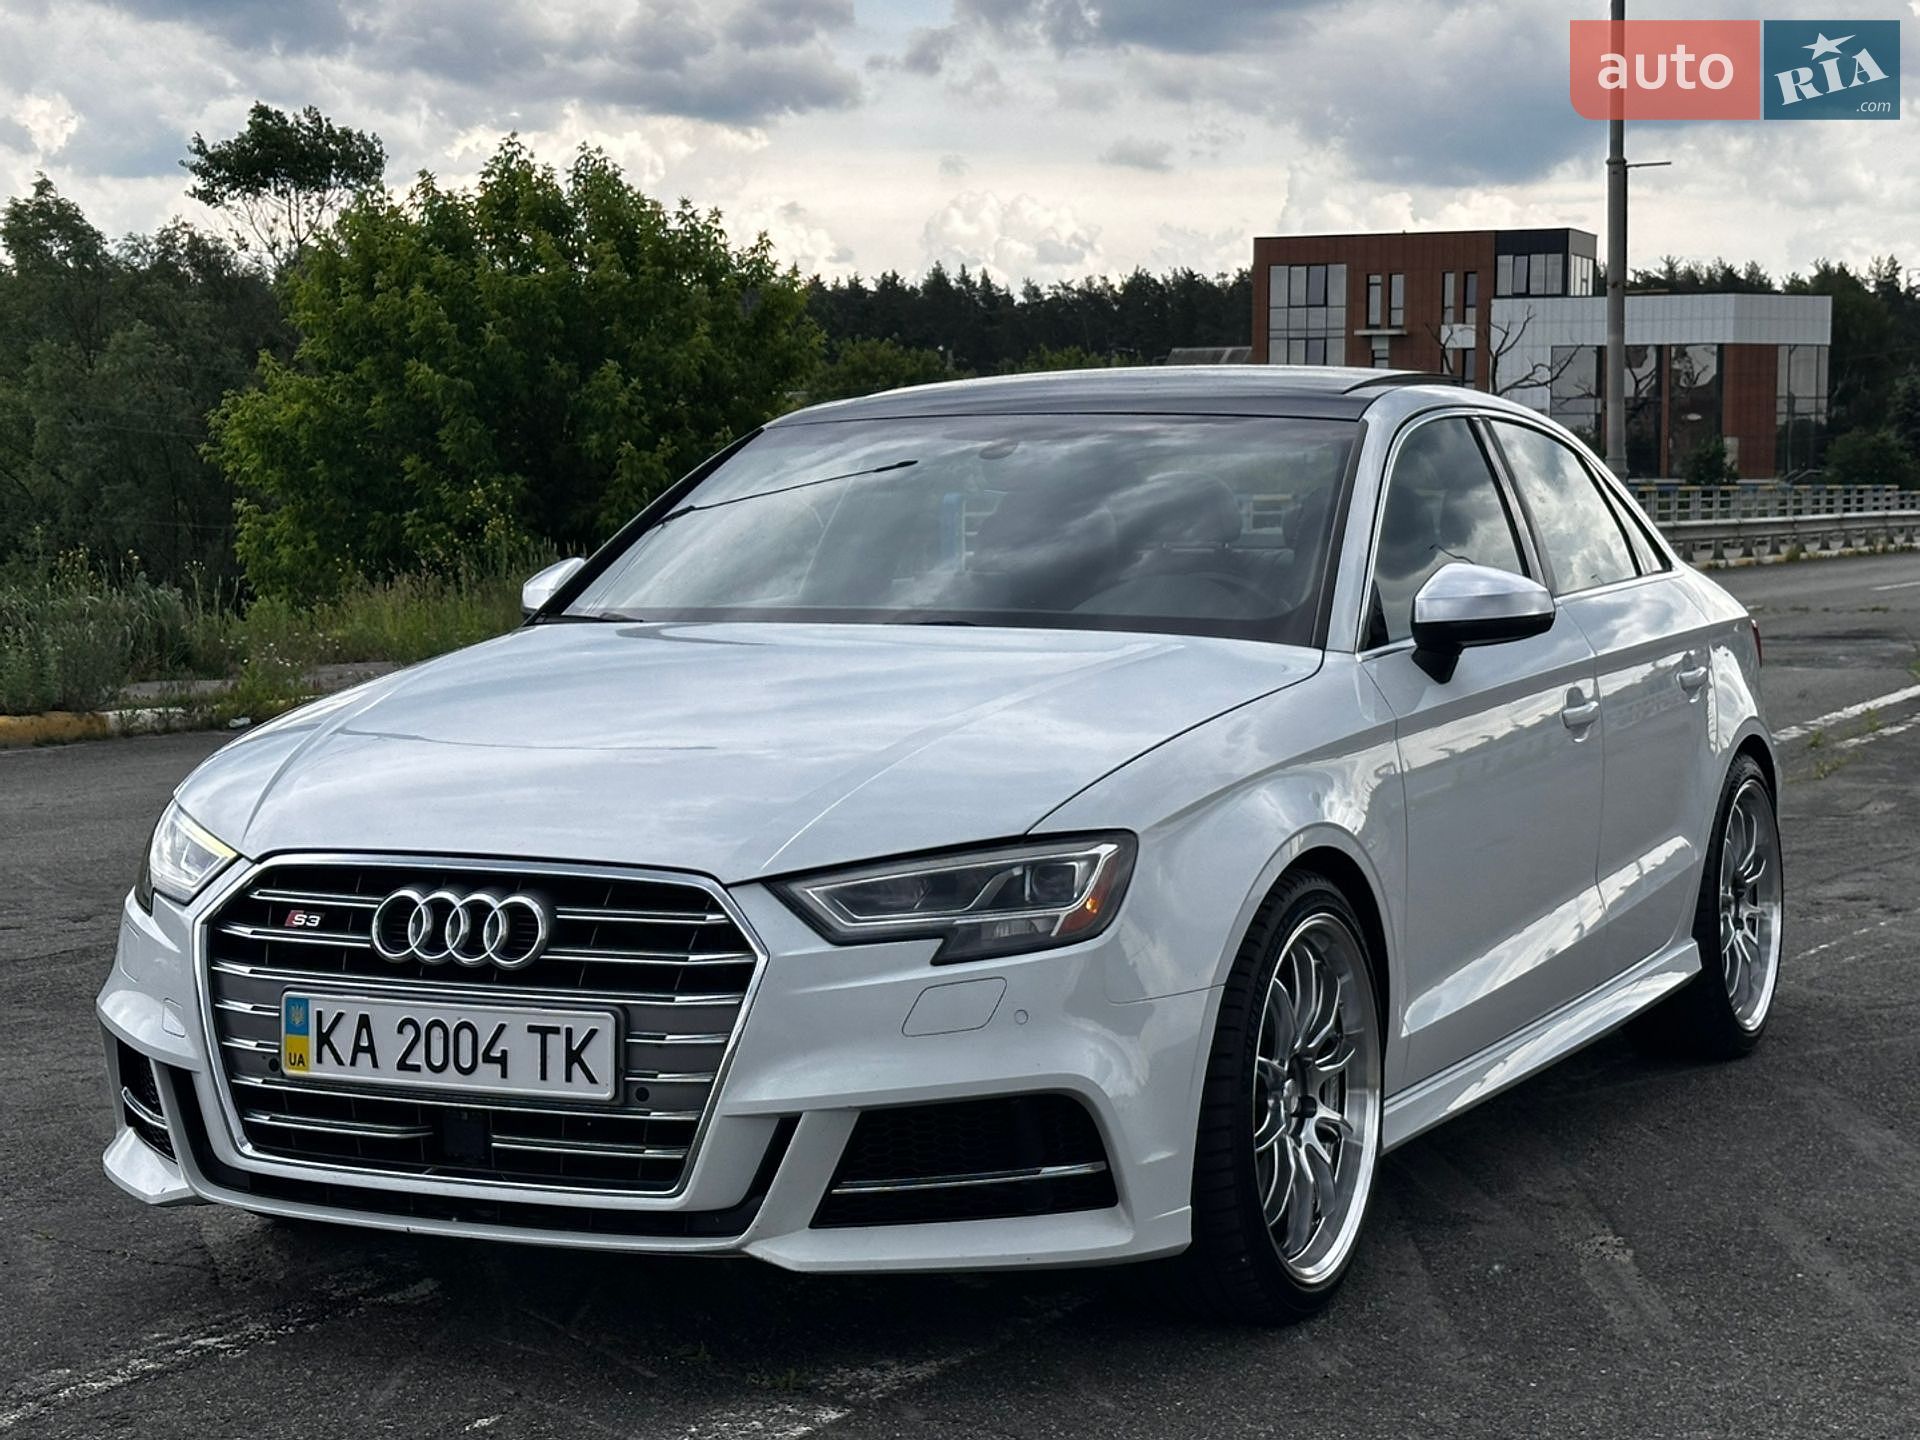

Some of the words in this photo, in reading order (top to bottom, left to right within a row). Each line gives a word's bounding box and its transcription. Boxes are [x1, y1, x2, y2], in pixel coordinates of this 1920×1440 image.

[292, 913, 321, 927] S3
[315, 1009, 380, 1069] KA
[395, 1017, 509, 1080] 2004
[526, 1023, 600, 1085] TK
[288, 1051, 306, 1068] UA
